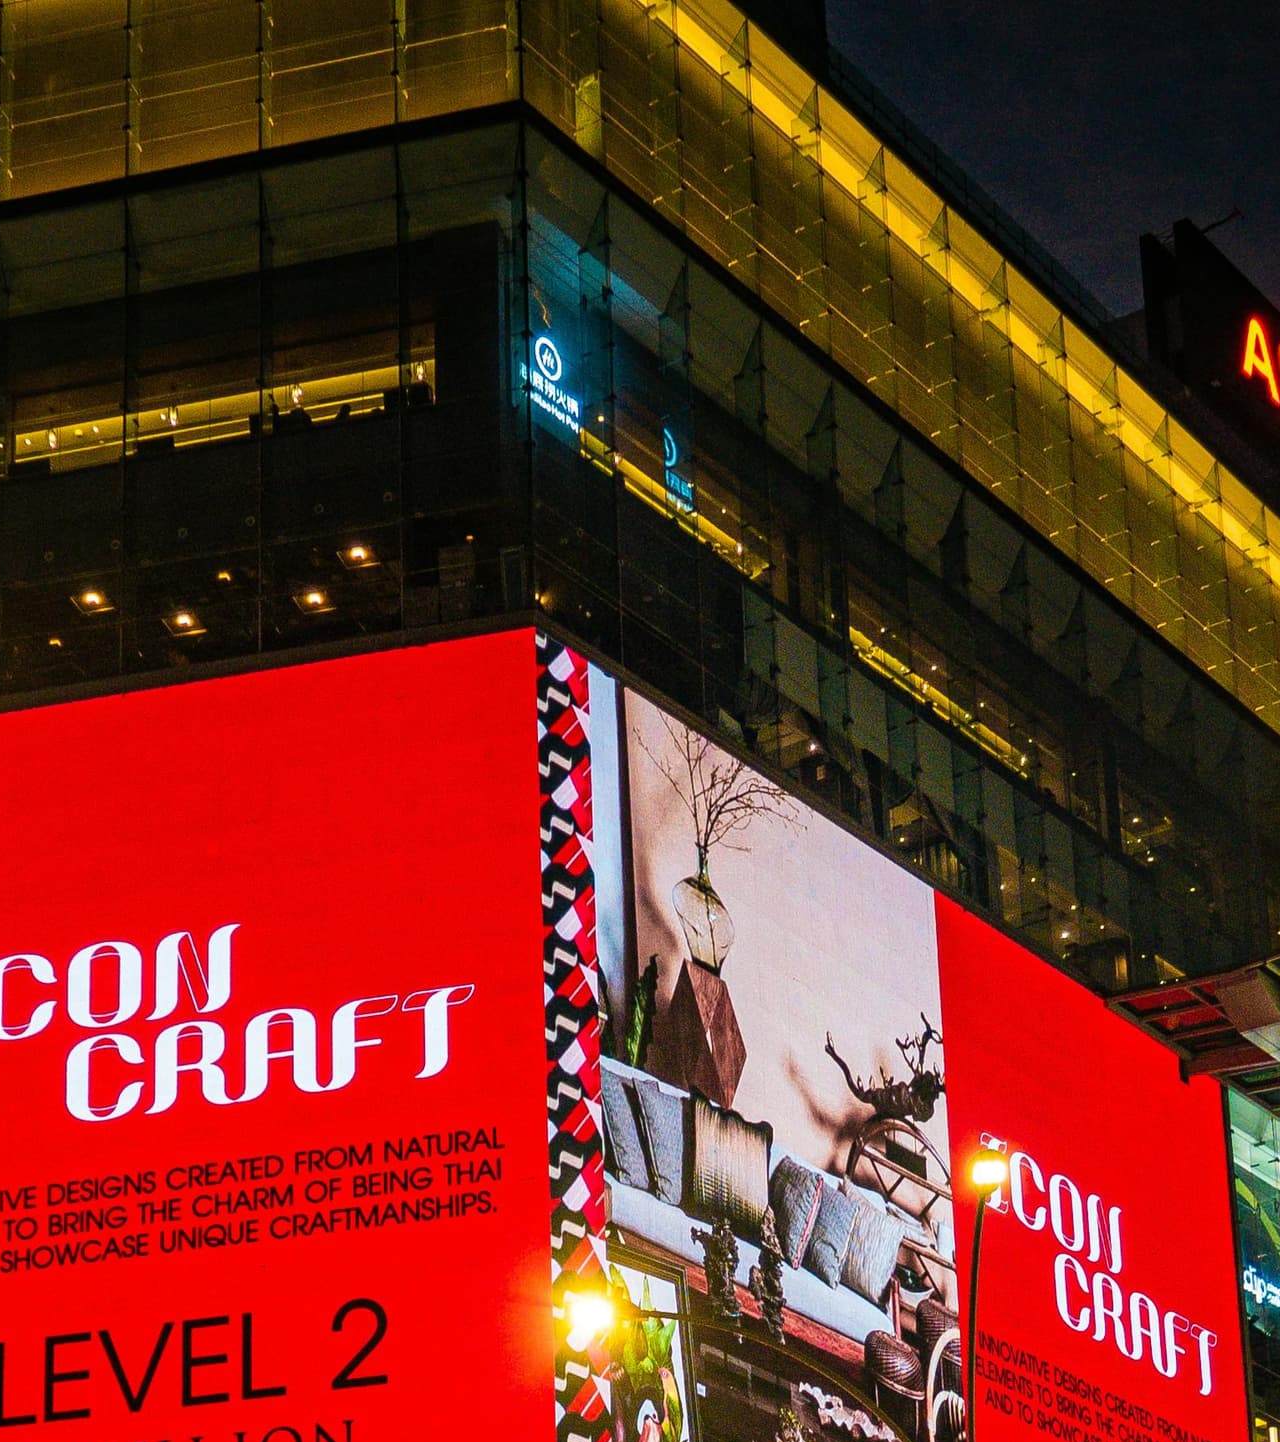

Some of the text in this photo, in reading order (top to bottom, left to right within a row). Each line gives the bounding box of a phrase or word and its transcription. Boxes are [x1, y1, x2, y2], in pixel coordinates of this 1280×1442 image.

[65, 984, 474, 1122] CRAFT
[5, 1217, 38, 1244] TO
[48, 1206, 128, 1238] BRING
[137, 1199, 183, 1226] THE
[191, 1185, 294, 1220] CHARM
[304, 1180, 343, 1206] OF
[352, 1166, 434, 1200] BEING
[443, 1158, 502, 1187] THAI
[46, 1171, 157, 1207] DESIGNS
[166, 1154, 284, 1191] CREATED
[294, 1143, 374, 1175] FROM
[383, 1127, 505, 1164] NATURAL
[0, 1234, 150, 1274] SHOWCASE
[159, 1222, 260, 1255] UNIQUE
[269, 1190, 498, 1241] CRAFTMANSHIPS.
[331, 1297, 389, 1391] 2
[1054, 1252, 1218, 1397] CRAFT
